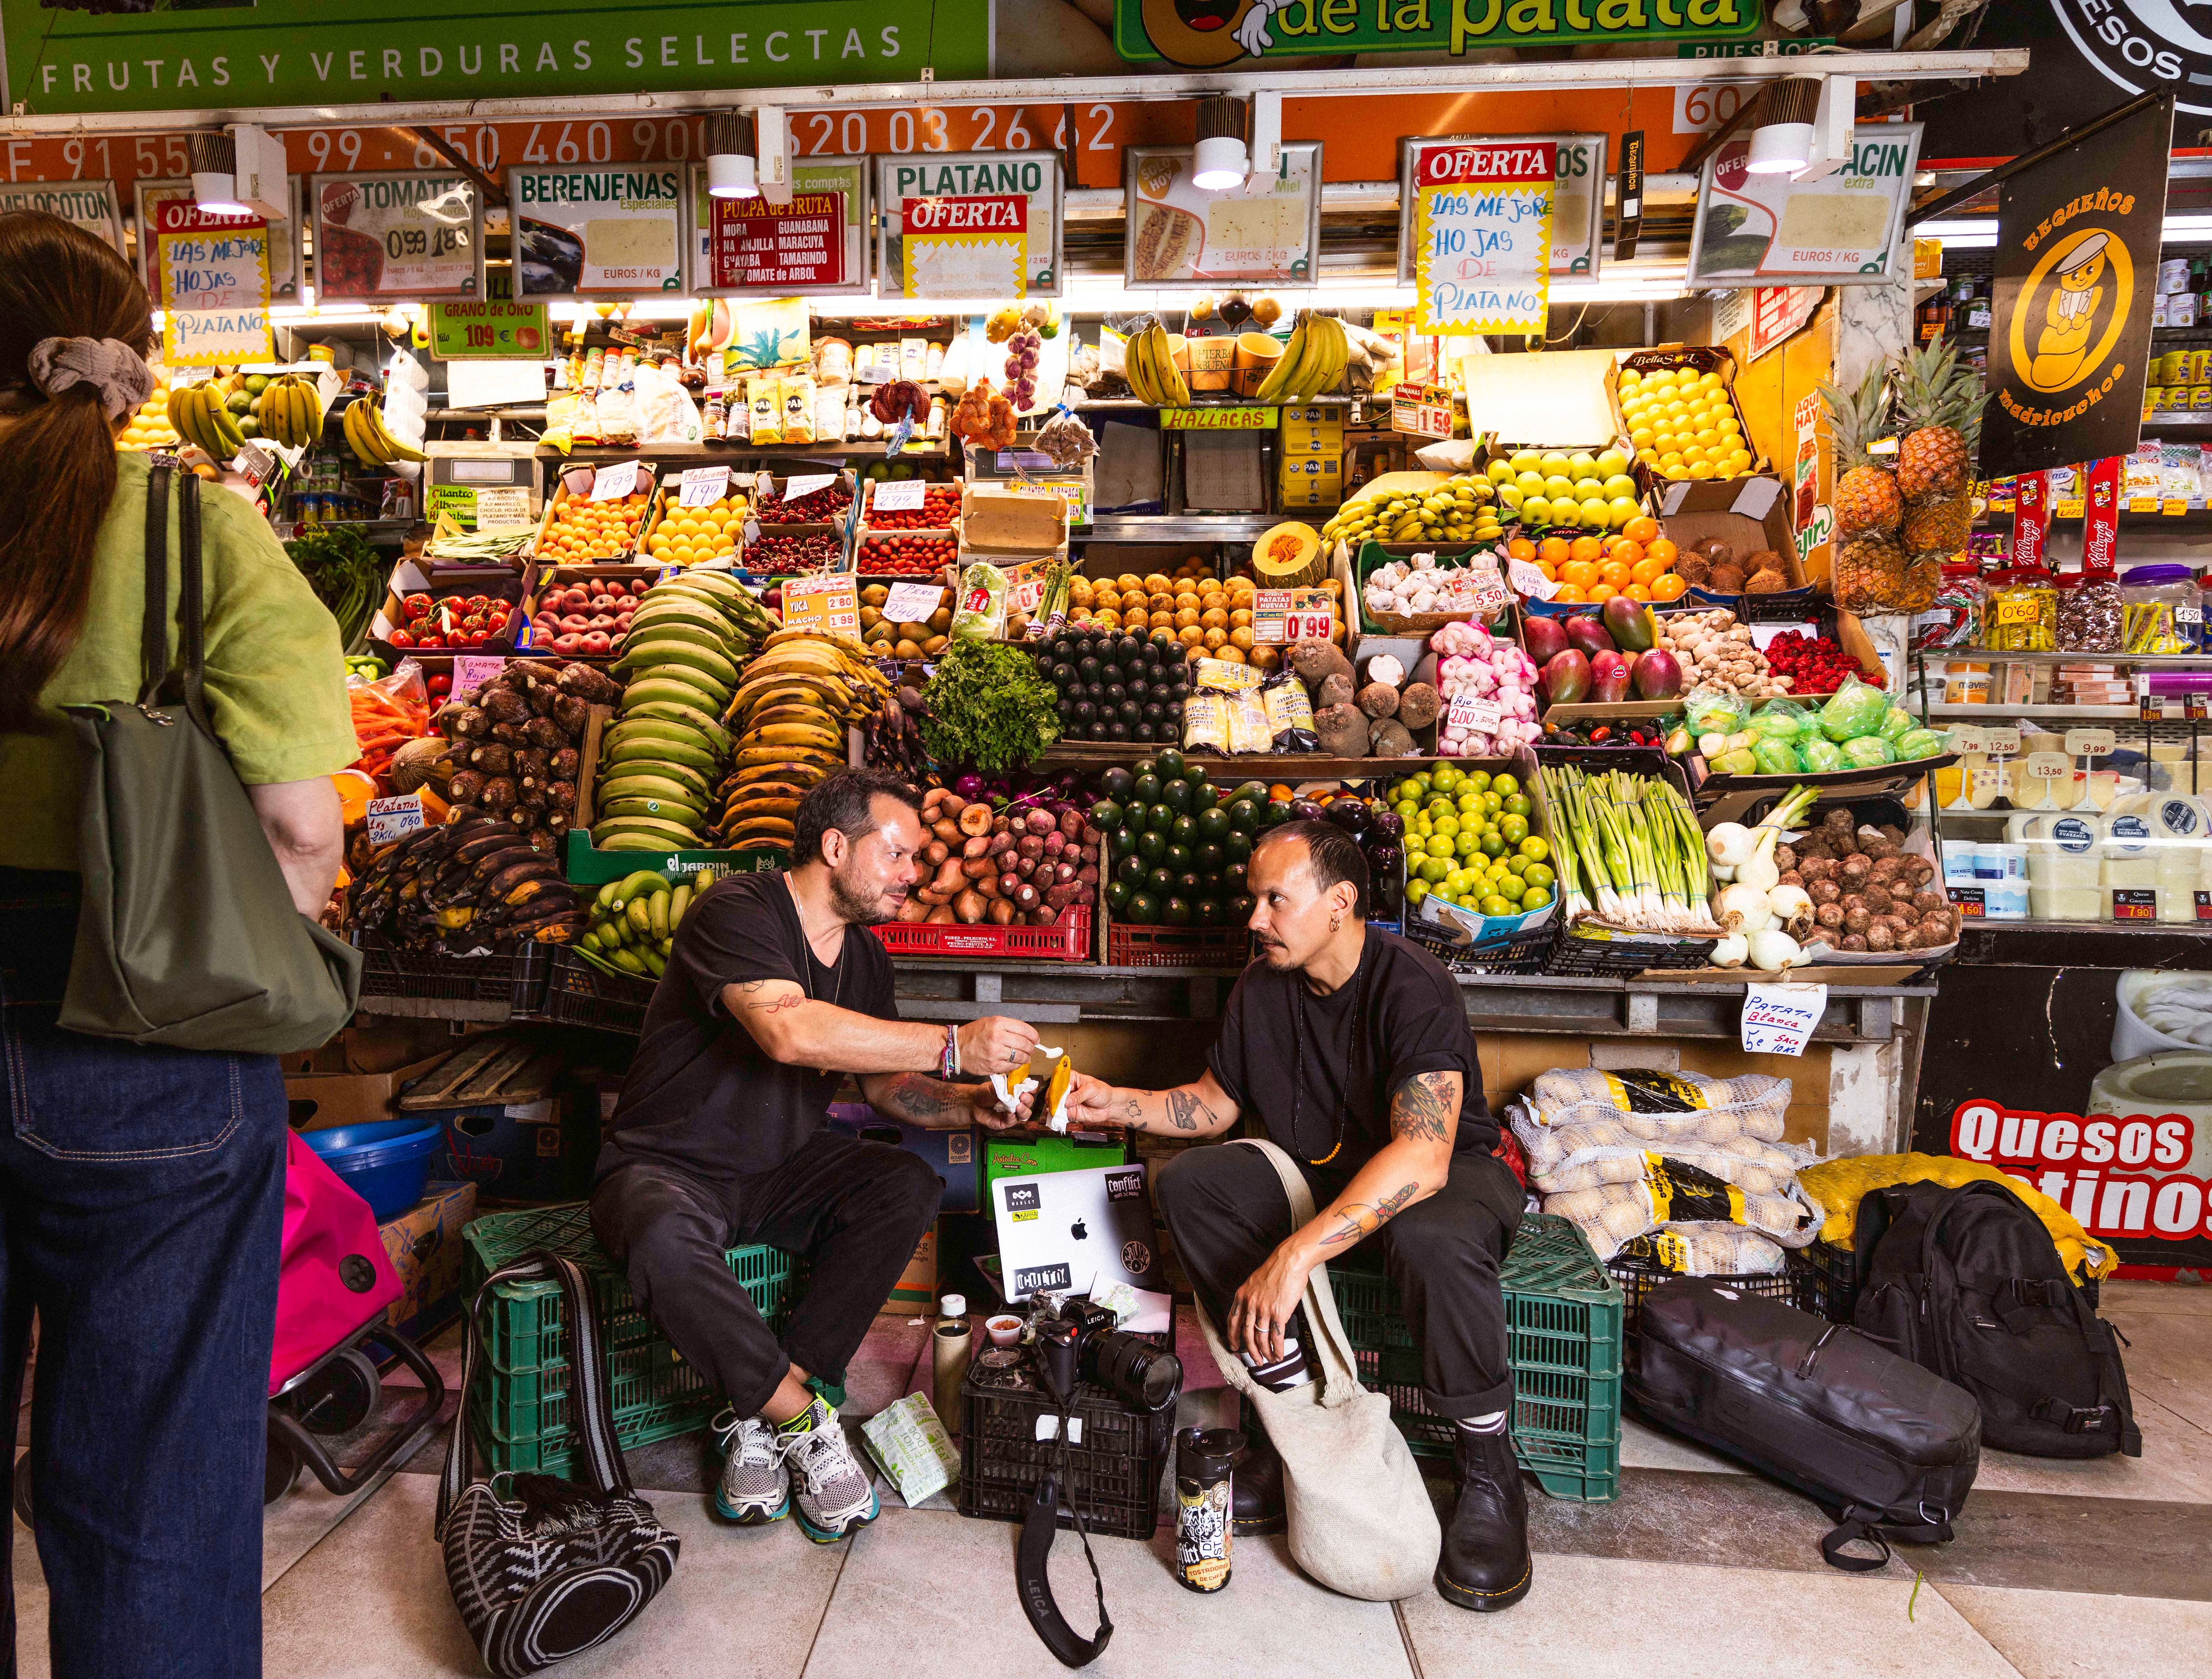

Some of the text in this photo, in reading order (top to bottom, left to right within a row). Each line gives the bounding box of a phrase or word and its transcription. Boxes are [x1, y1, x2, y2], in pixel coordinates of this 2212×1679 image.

[1276, 0, 1741, 57] de la patata
[42, 26, 901, 94] FRUTAS Y VERDURAS SELECTAS
[1685, 86, 1741, 125] 60
[889, 106, 1031, 153] 03 26
[64, 139, 111, 177] 91
[413, 125, 500, 166] 650
[522, 121, 612, 165] 460
[1429, 149, 1548, 179] OFERTA
[521, 171, 678, 203] BERENJENAS
[804, 177, 852, 192] compras
[897, 162, 1041, 196] PLATANO
[1148, 171, 1173, 192] HOY
[1275, 180, 1301, 193] Miel
[1843, 177, 1875, 190] extra
[323, 188, 360, 214] OFERTA
[619, 196, 677, 212] Especiales
[722, 196, 833, 219] PULPA de FRUTA
[1431, 194, 1469, 216] LAS
[911, 201, 1020, 228] OFERTA
[722, 222, 748, 238] MORA
[778, 219, 830, 234] GUANABANA
[778, 235, 824, 250] MARACUYA
[173, 243, 206, 263] LAS
[779, 251, 827, 266] TAMARINDO
[1225, 250, 1287, 262] EUROS KG
[1553, 249, 1568, 259] KG
[1792, 250, 1859, 262] EUROS KG
[603, 266, 661, 280] EUROS KG
[776, 267, 817, 281] de ARBOL
[1456, 257, 1497, 280] DE
[177, 270, 236, 294] HOJAS
[195, 290, 234, 310] DE
[1433, 282, 1537, 319] PLATANO
[444, 303, 534, 318] GRANO de ORO
[177, 312, 264, 344] PLATANO
[1198, 349, 1231, 359] HIERBA
[1202, 360, 1230, 370] BUENA
[1398, 386, 1421, 396] BANANAS
[753, 400, 772, 410] PAN
[786, 399, 804, 410] PAN
[1165, 411, 1265, 429] HALLACAS
[1795, 407, 1819, 430] HAY
[1304, 464, 1321, 472] PAN
[431, 488, 473, 499] Cilantro
[683, 484, 720, 505] 1'99
[789, 599, 810, 614] YUCA
[2002, 605, 2036, 618] 0'60
[787, 615, 823, 626] MACHO
[2178, 610, 2199, 621] 1'50
[1961, 740, 1978, 751] 7,99
[1990, 742, 2015, 751] 12,50
[2082, 743, 2106, 753] 9,99
[2037, 766, 2062, 776] 13,50
[667, 853, 730, 873] el JARDIN
[1747, 997, 1813, 1019] PATATA
[1747, 1012, 1799, 1028] Blanca
[1958, 1106, 2186, 1165] Quesos
[1021, 1152, 1038, 1167] Corn
[1087, 1314, 1105, 1325] LEICA
[791, 1418, 810, 1434] saucony
[901, 1432, 918, 1452] HOT
[908, 1425, 926, 1449] DOG
[934, 1446, 951, 1463] EAT
[1189, 1562, 1229, 1577] TOSTADORES
[1028, 1578, 1050, 1619] LEICA
